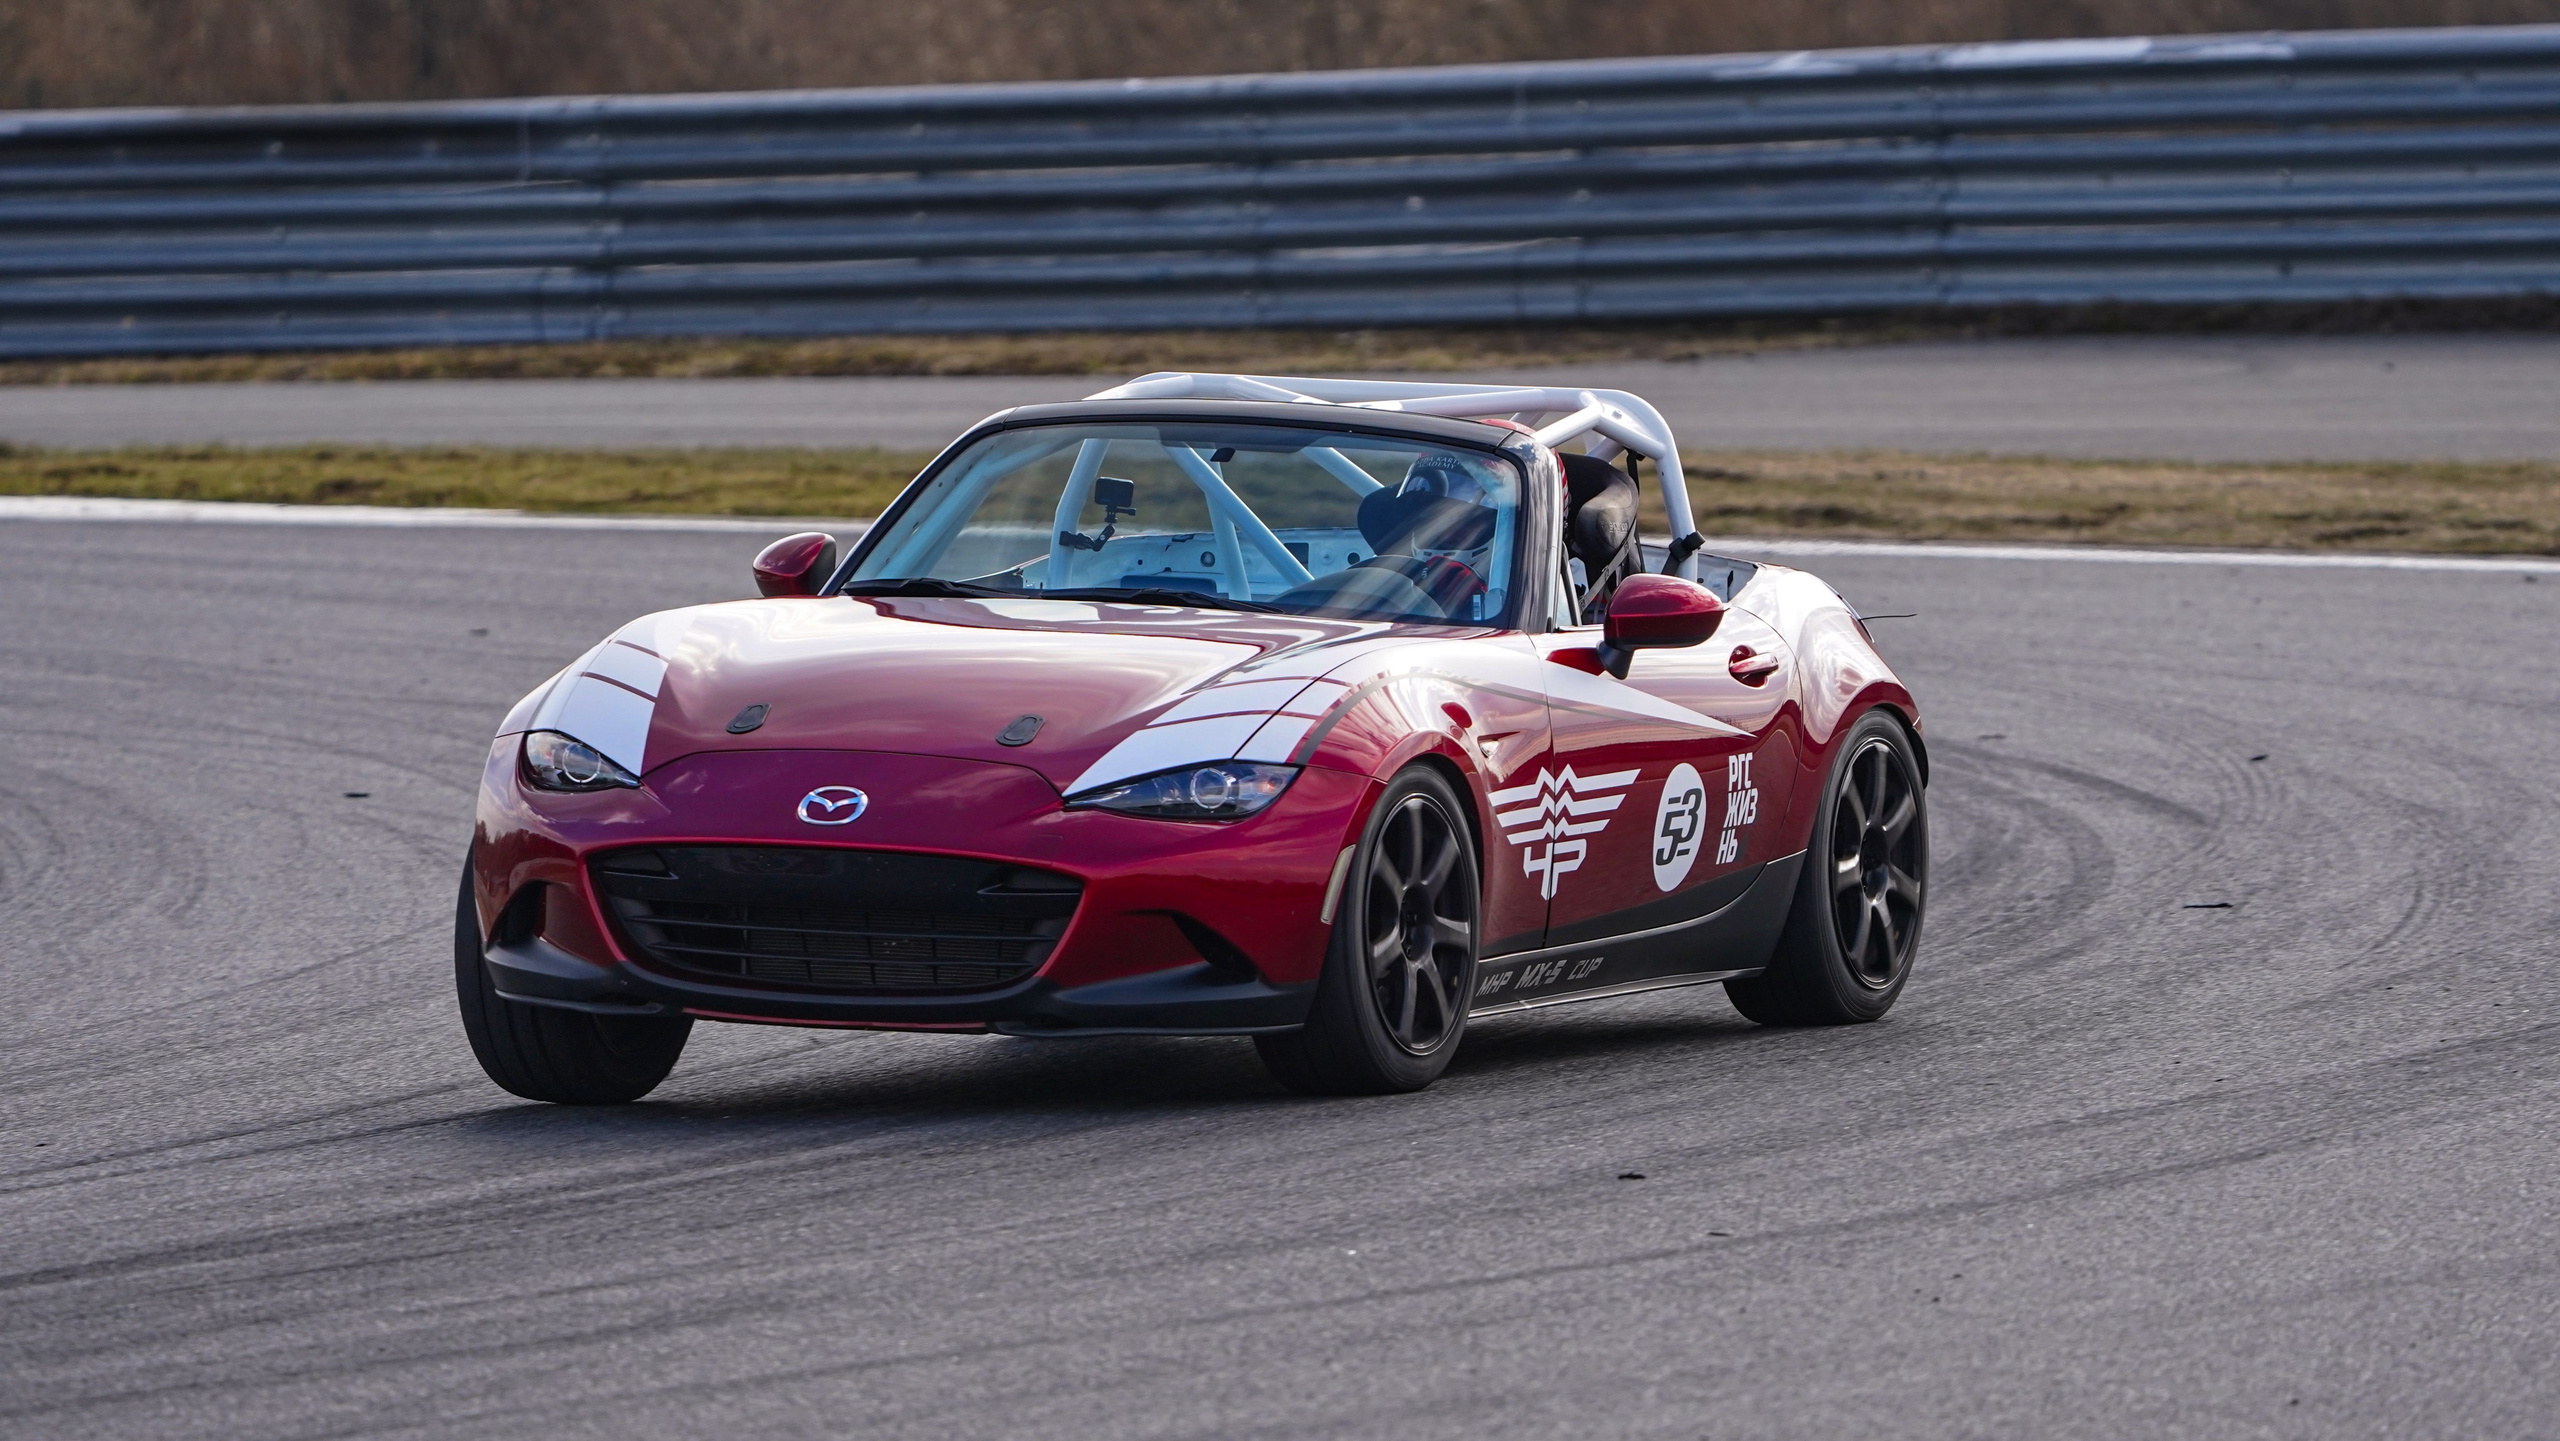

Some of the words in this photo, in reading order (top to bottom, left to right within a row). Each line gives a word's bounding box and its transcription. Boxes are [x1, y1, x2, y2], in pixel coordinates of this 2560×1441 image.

[1728, 752, 1753, 792] РГС
[1655, 787, 1703, 867] 53
[1723, 787, 1759, 828] ЖИЗ
[1715, 828, 1738, 865] НЬ
[1514, 959, 1568, 990] MX-5
[1567, 956, 1605, 981] CUP
